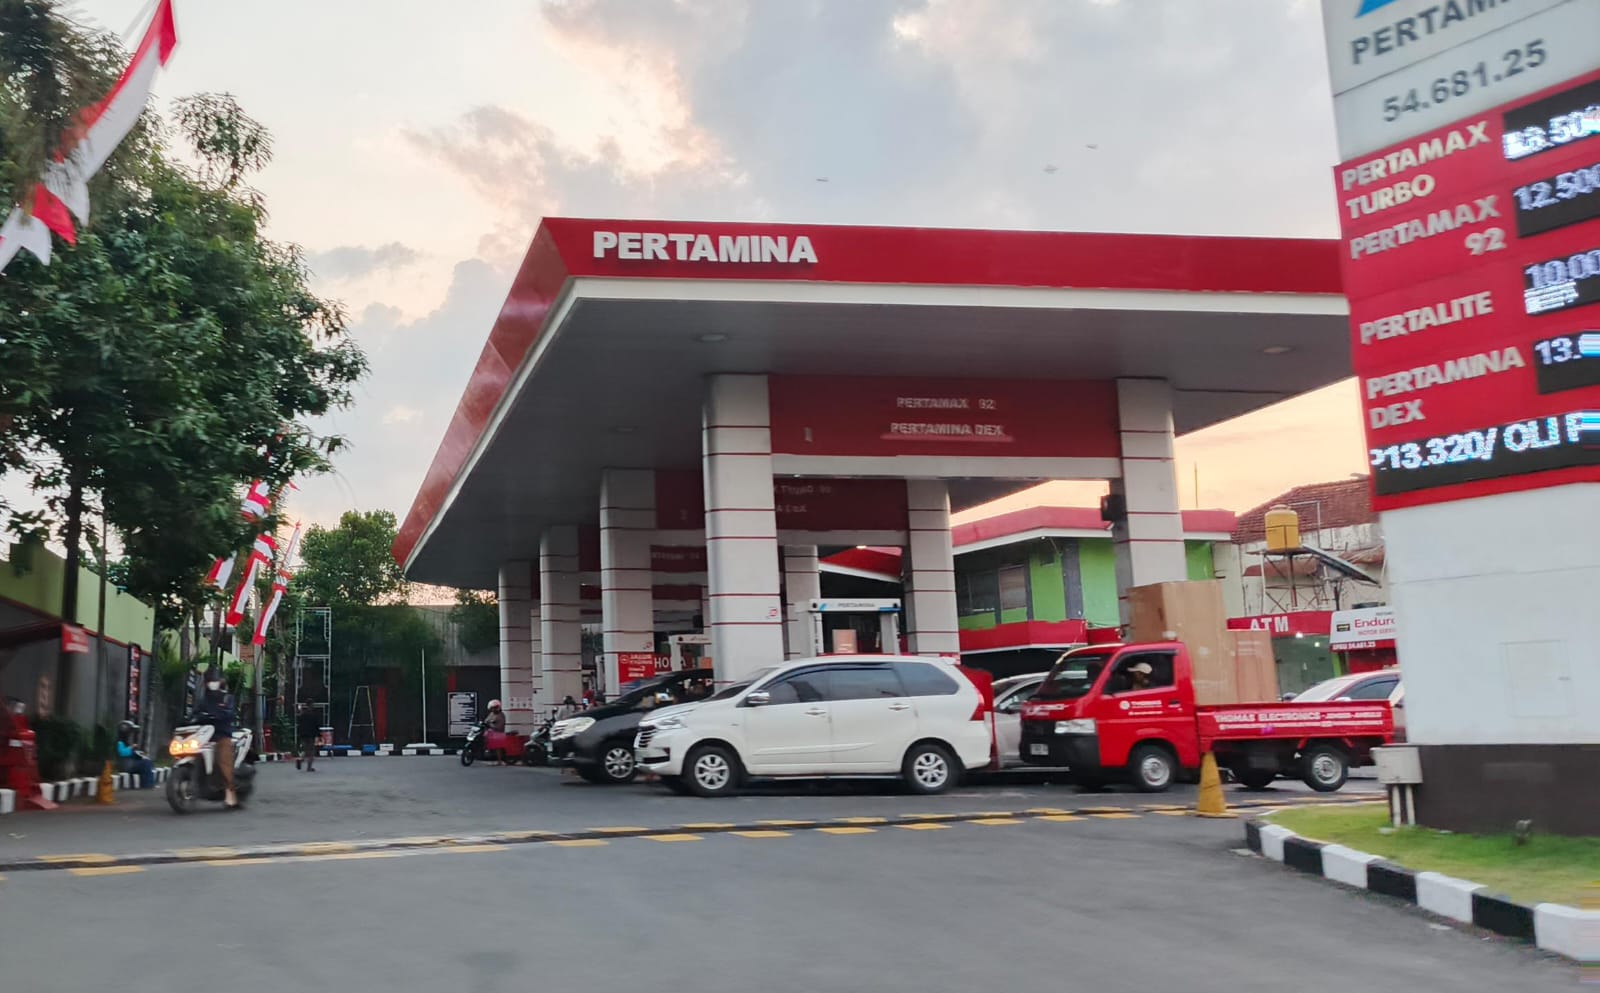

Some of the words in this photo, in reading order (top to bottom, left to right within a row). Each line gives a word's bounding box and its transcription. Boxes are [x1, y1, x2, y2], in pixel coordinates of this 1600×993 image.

[1384, 39, 1547, 122] 54.681.25
[1342, 121, 1492, 190] PERTAMAX
[1346, 174, 1435, 218] TURBO
[1350, 195, 1502, 260] PERTAMAX
[1465, 227, 1507, 256] 92
[593, 231, 818, 263] PERTAMINA
[1360, 291, 1494, 344] PERTALITE
[1366, 347, 1526, 399] PERTAMINA
[897, 396, 970, 409] PERTAMAX
[1369, 399, 1425, 429] DEX
[890, 422, 973, 435] PERTAMINA
[1250, 616, 1288, 632] ATM
